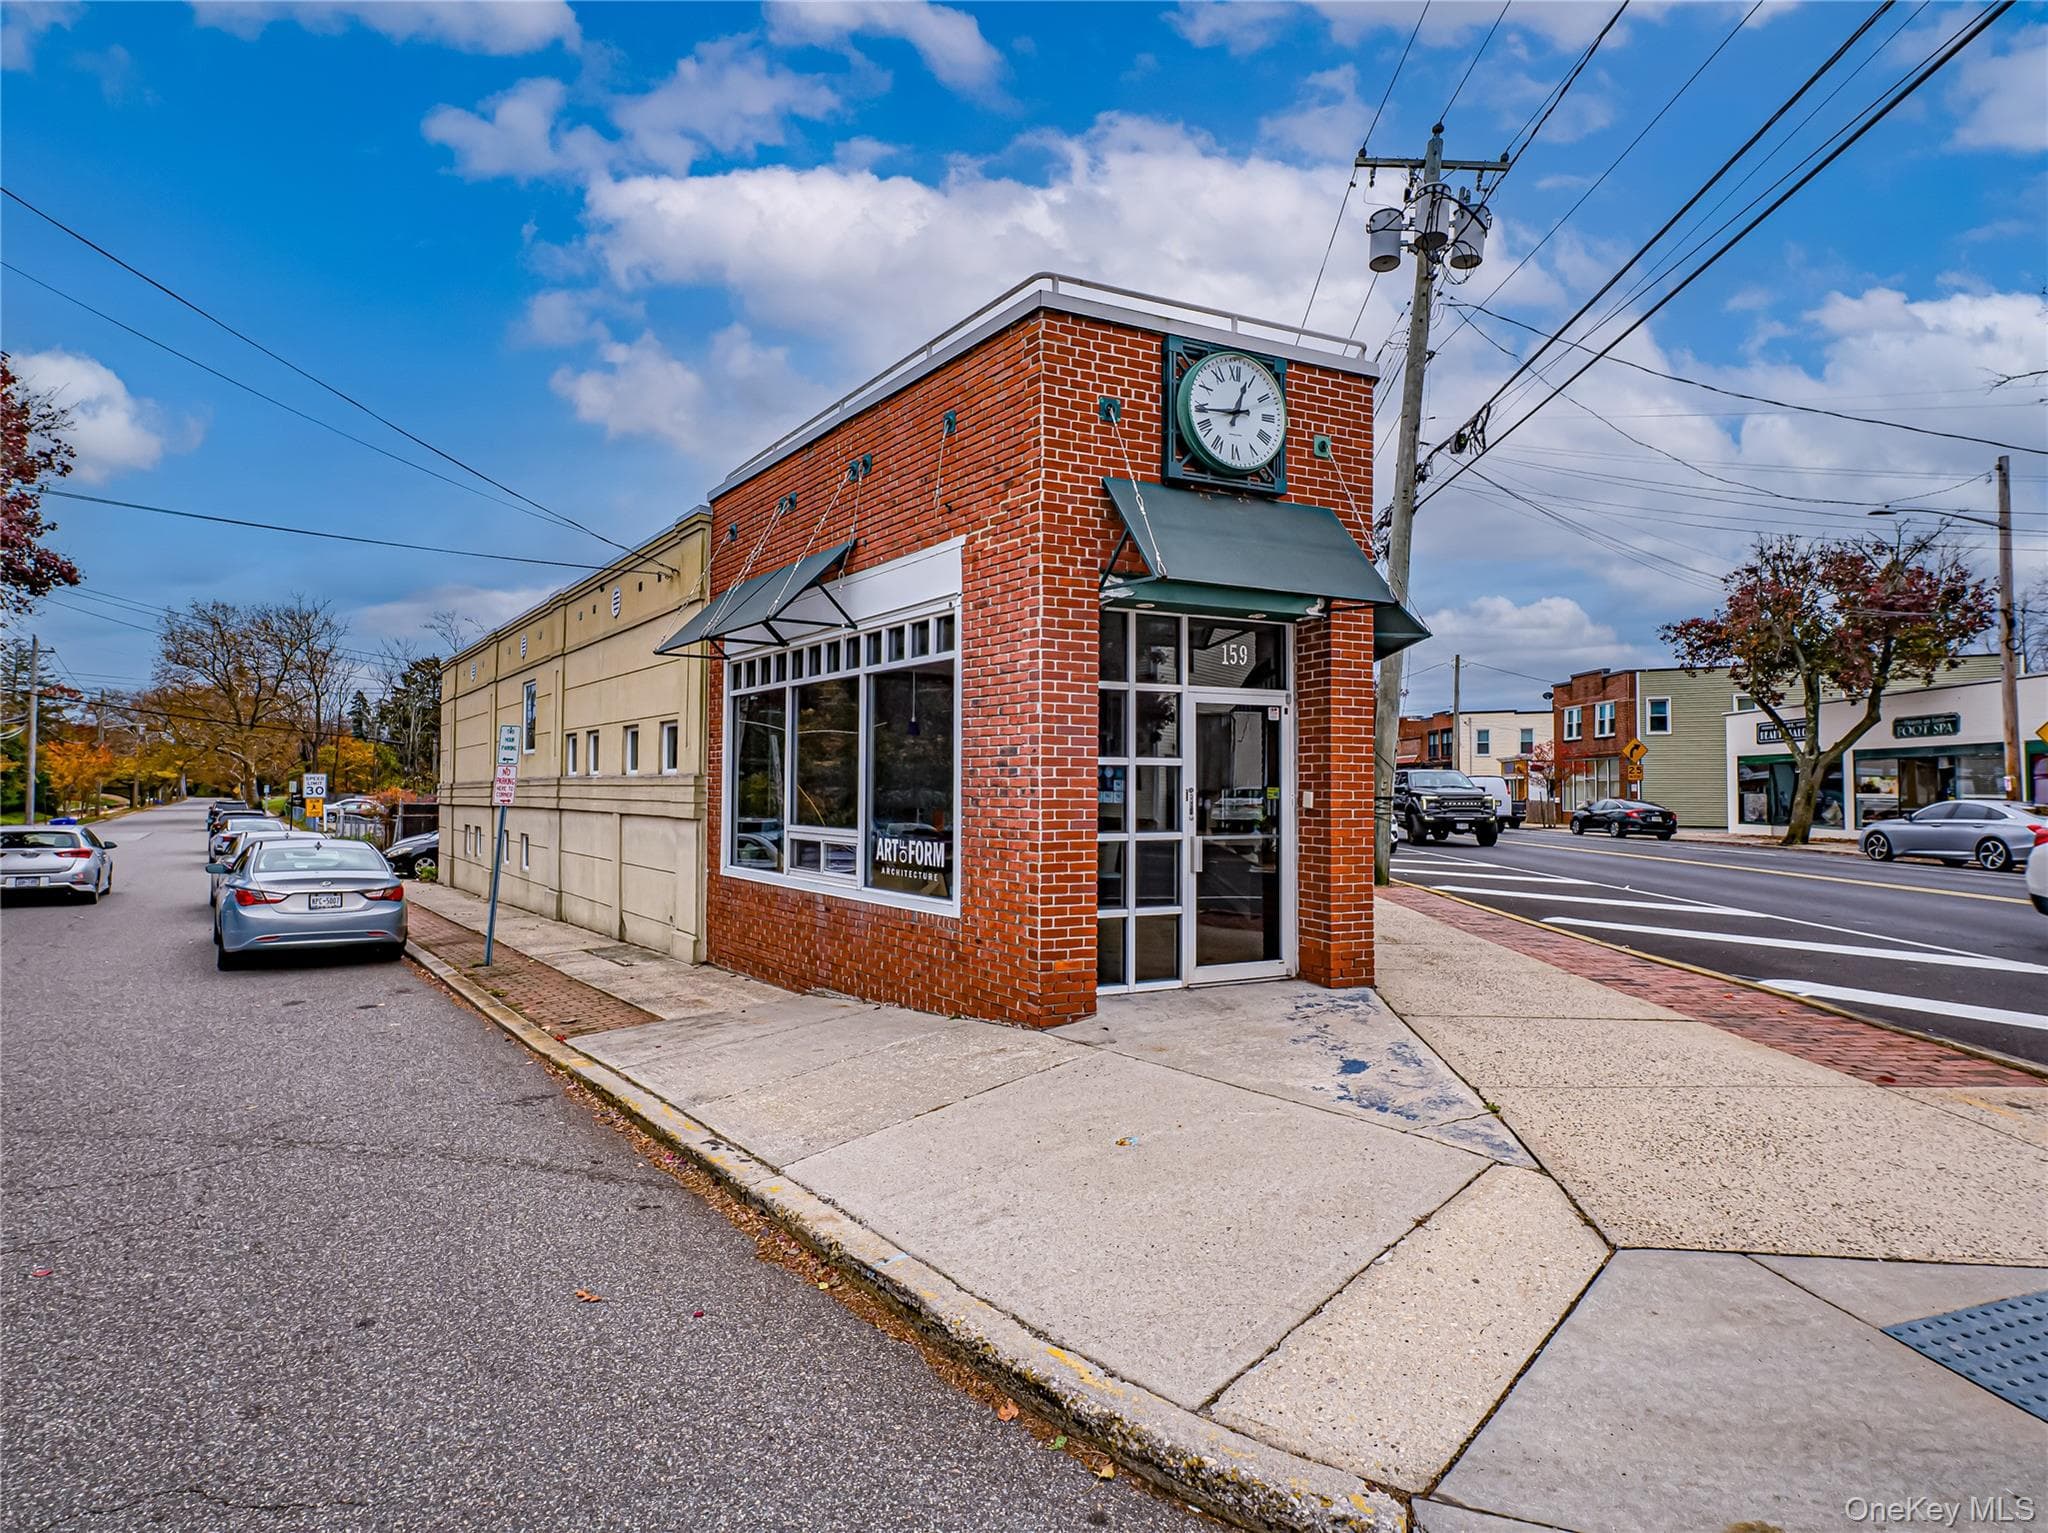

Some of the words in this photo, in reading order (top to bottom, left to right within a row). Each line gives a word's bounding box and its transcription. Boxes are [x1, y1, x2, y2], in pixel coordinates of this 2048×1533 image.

[1221, 644, 1248, 666] 159
[1897, 725, 1929, 737] FOOT
[1933, 722, 1954, 735] SPA
[502, 768, 511, 776] NO
[496, 777, 515, 785] PARKING
[306, 786, 324, 795] 30
[876, 837, 899, 863] ART
[908, 839, 945, 869] FORM
[880, 866, 939, 882] ARCHITECTURE
